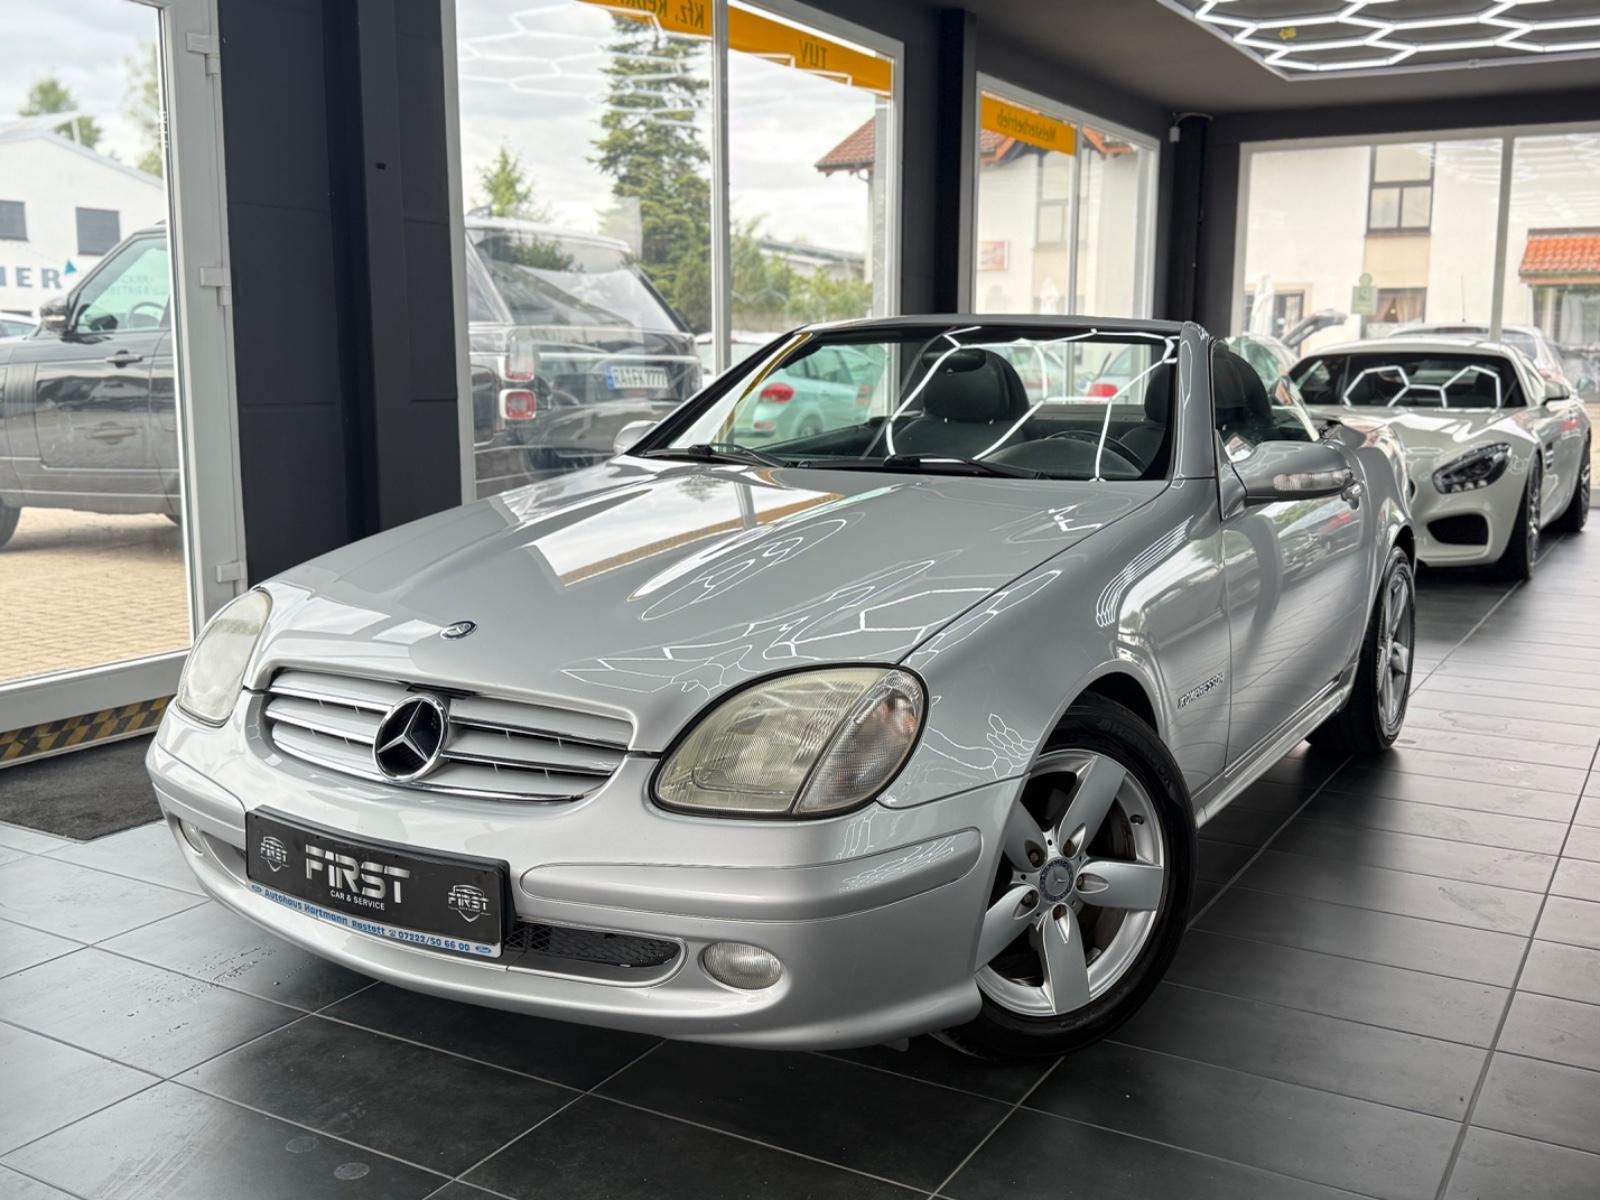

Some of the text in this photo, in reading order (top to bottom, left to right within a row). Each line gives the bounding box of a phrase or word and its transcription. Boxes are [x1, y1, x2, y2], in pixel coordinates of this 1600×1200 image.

[261, 842, 287, 862] FIRST
[305, 843, 411, 904] FIRST
[330, 889, 385, 911] CAR & SERVICE
[447, 892, 489, 911] FIRST
[265, 889, 302, 910] Autohaus
[304, 903, 348, 926] Hartmann
[352, 920, 385, 936] Rastatt
[398, 931, 442, 946] 07222/50
[458, 942, 470, 952] 00
